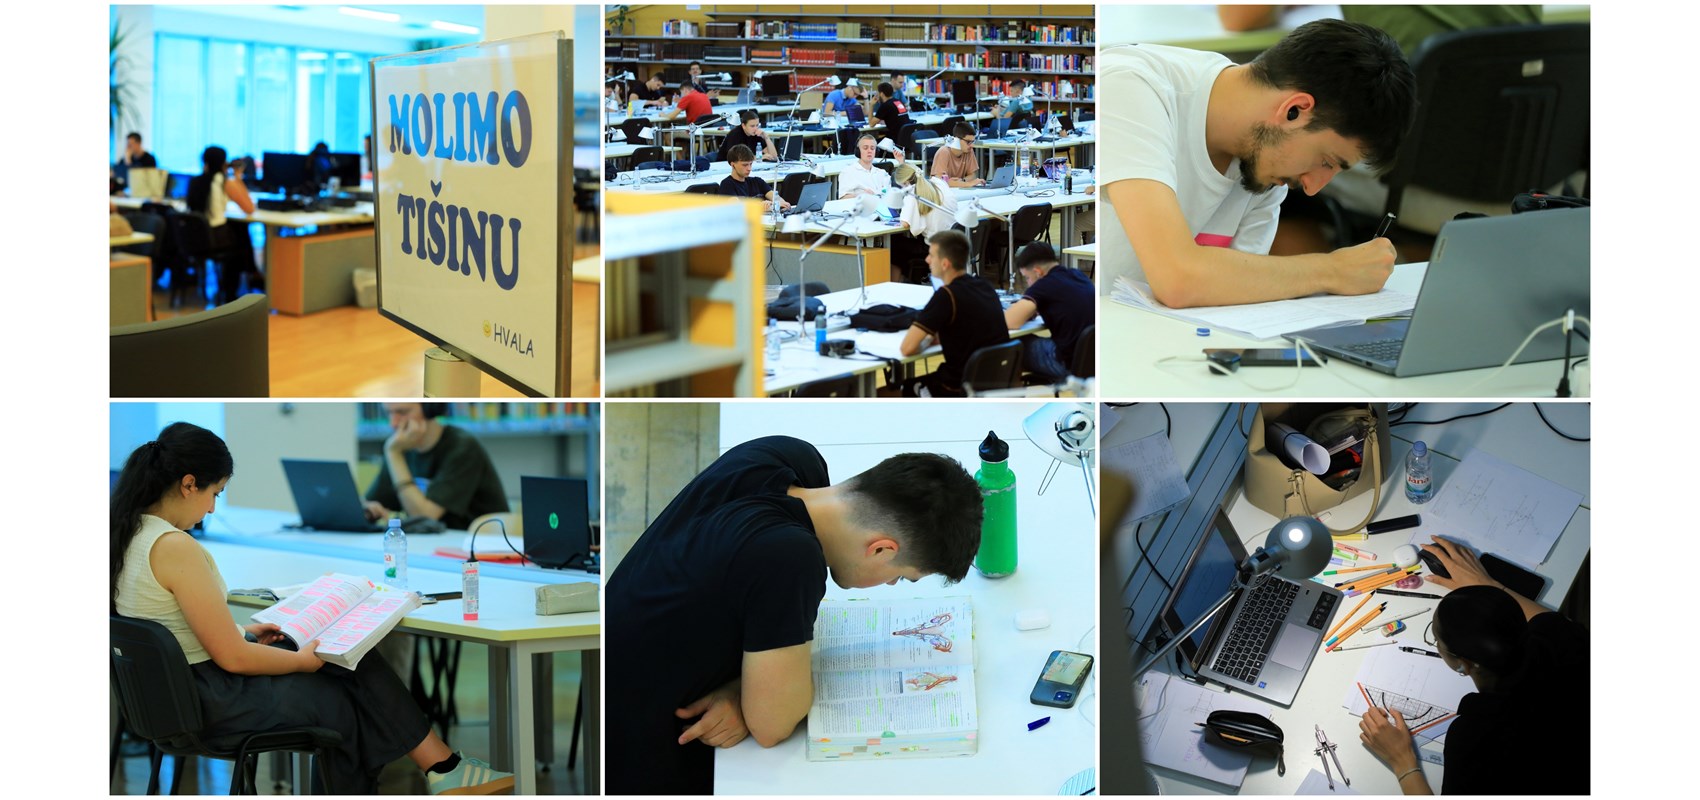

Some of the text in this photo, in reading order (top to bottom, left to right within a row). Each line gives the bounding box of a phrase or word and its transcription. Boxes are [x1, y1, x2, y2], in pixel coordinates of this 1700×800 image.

[388, 90, 532, 168] MOLIMO
[397, 179, 522, 291] TIŠINU
[494, 322, 534, 358] HVALA
